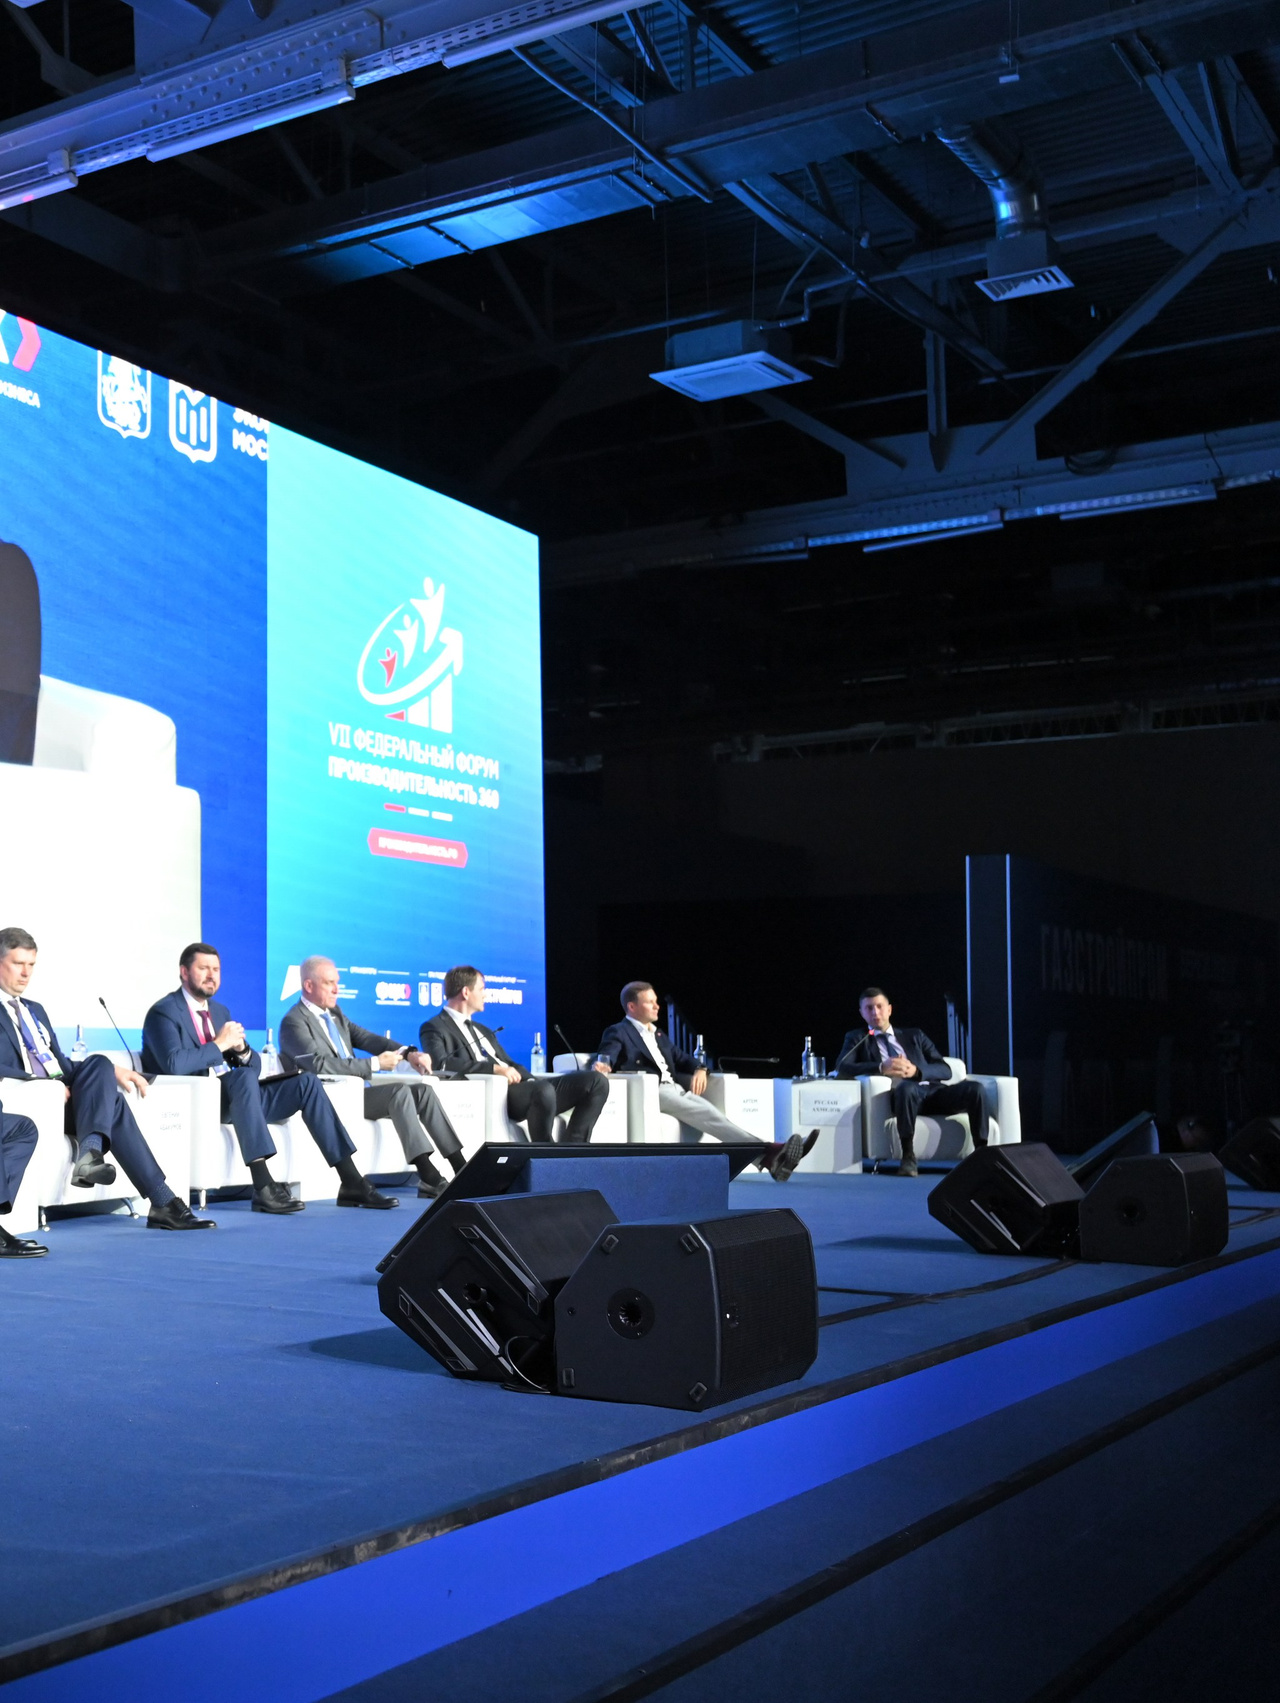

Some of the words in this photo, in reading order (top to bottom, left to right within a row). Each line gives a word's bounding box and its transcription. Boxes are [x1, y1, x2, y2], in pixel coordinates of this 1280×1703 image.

[328, 721, 351, 749] VII
[353, 727, 455, 770] ФЕДЕРАЛЬНЫЙ
[455, 751, 500, 781] ФОРУМ
[328, 755, 478, 806] ПРОИЗВОДИТЕЛЬНОСТЬ
[477, 786, 500, 810] 360
